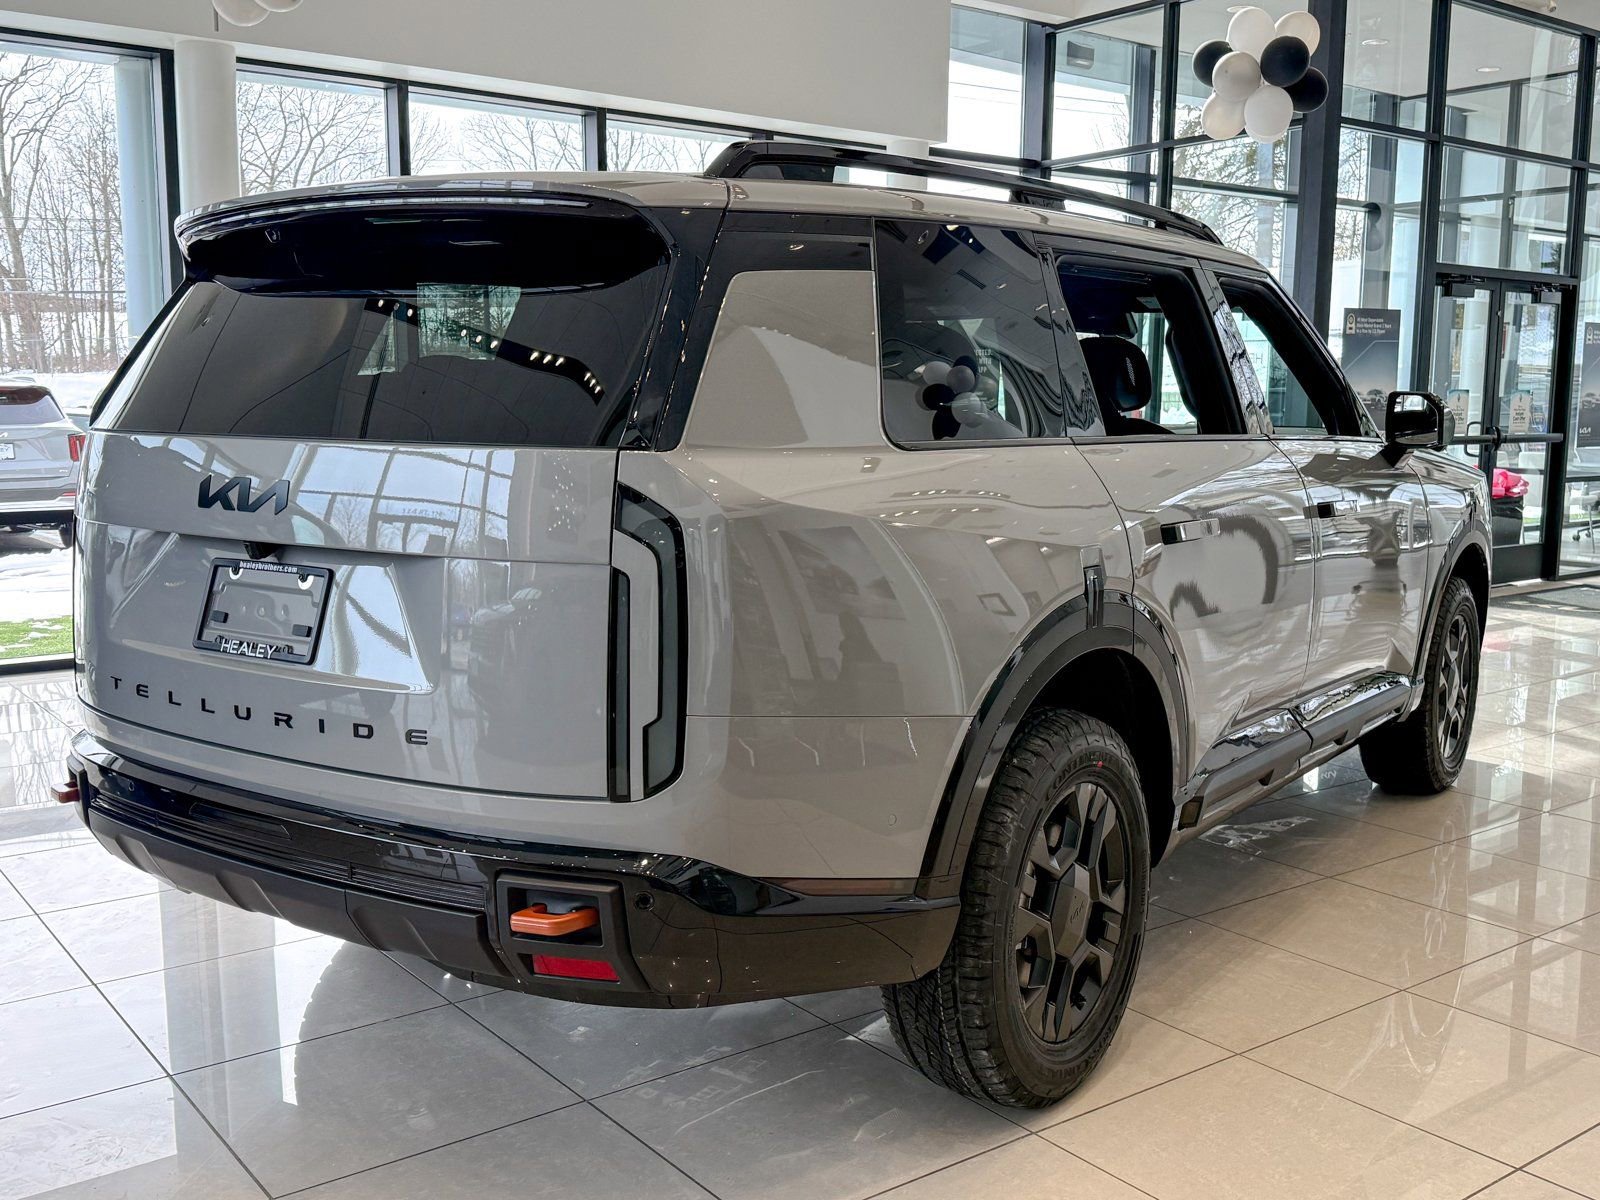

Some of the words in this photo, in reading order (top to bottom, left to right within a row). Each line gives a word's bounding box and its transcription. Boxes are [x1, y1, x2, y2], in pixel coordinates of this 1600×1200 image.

[198, 474, 290, 516] KIA
[220, 638, 277, 660] HEALEY
[110, 675, 428, 746] TELLURIDE
